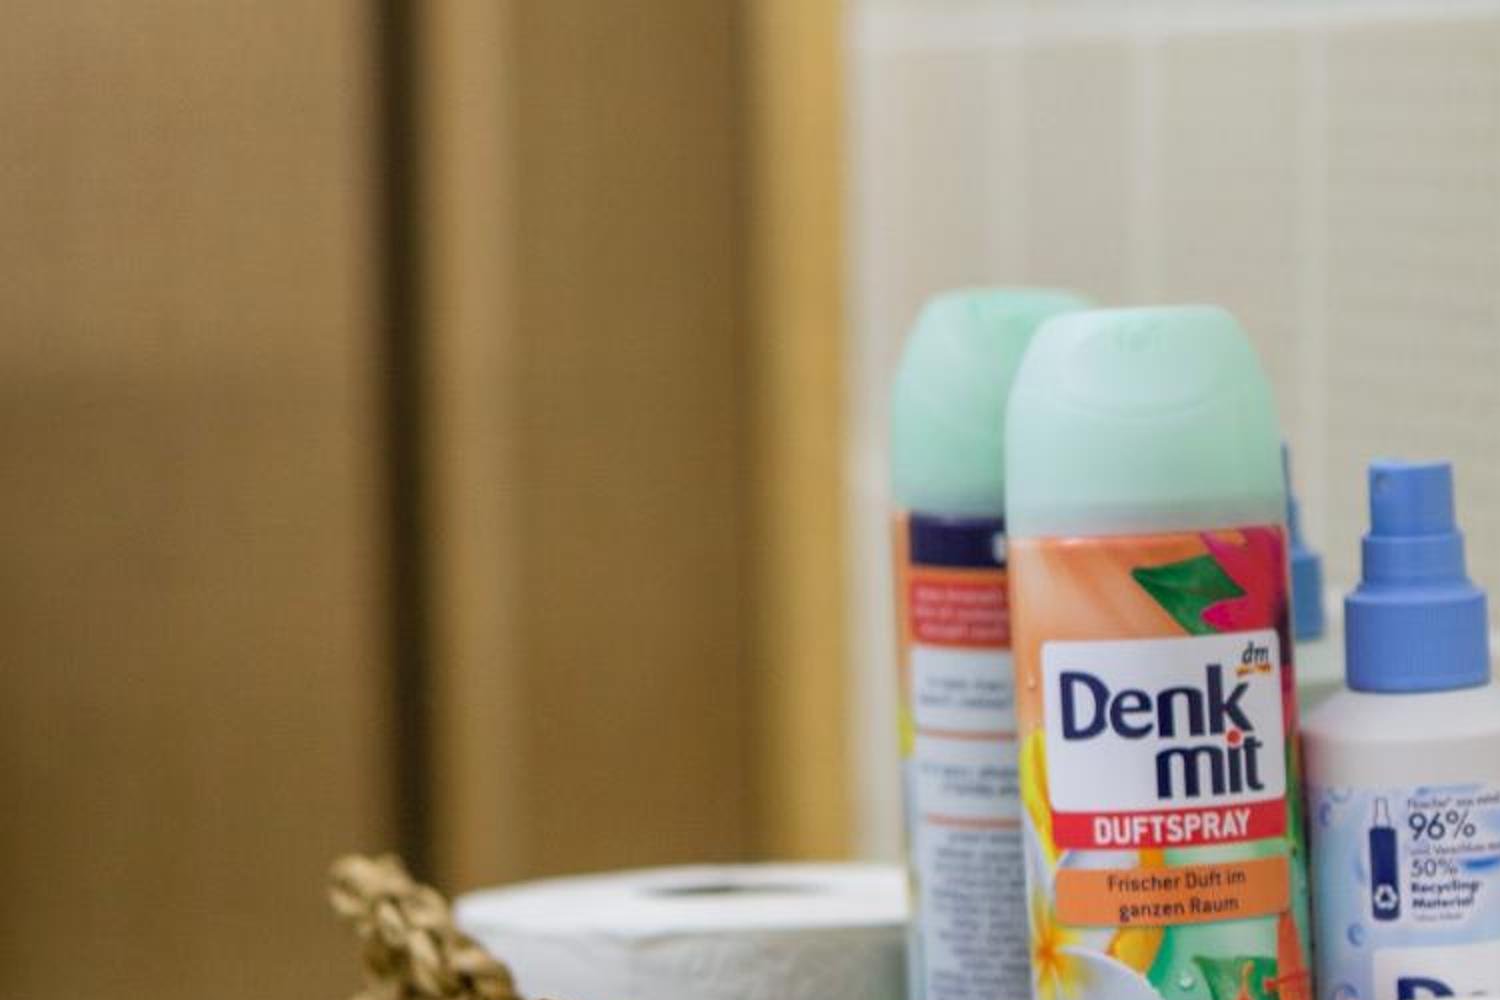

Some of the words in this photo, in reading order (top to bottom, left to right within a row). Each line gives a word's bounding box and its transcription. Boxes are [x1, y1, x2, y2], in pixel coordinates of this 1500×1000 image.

[1241, 640, 1270, 665] dm
[1059, 663, 1254, 741] Denk
[1155, 728, 1265, 801] mit
[1093, 807, 1251, 846] DUFTSPRAY
[1408, 808, 1476, 842] 96%
[1106, 872, 1181, 893] Frischer
[1184, 869, 1222, 890] Duft
[1226, 868, 1247, 885] im
[1410, 858, 1459, 878] 50%
[1118, 901, 1185, 923] ganzen
[1189, 896, 1240, 914] Raum
[1411, 895, 1475, 910] Material
